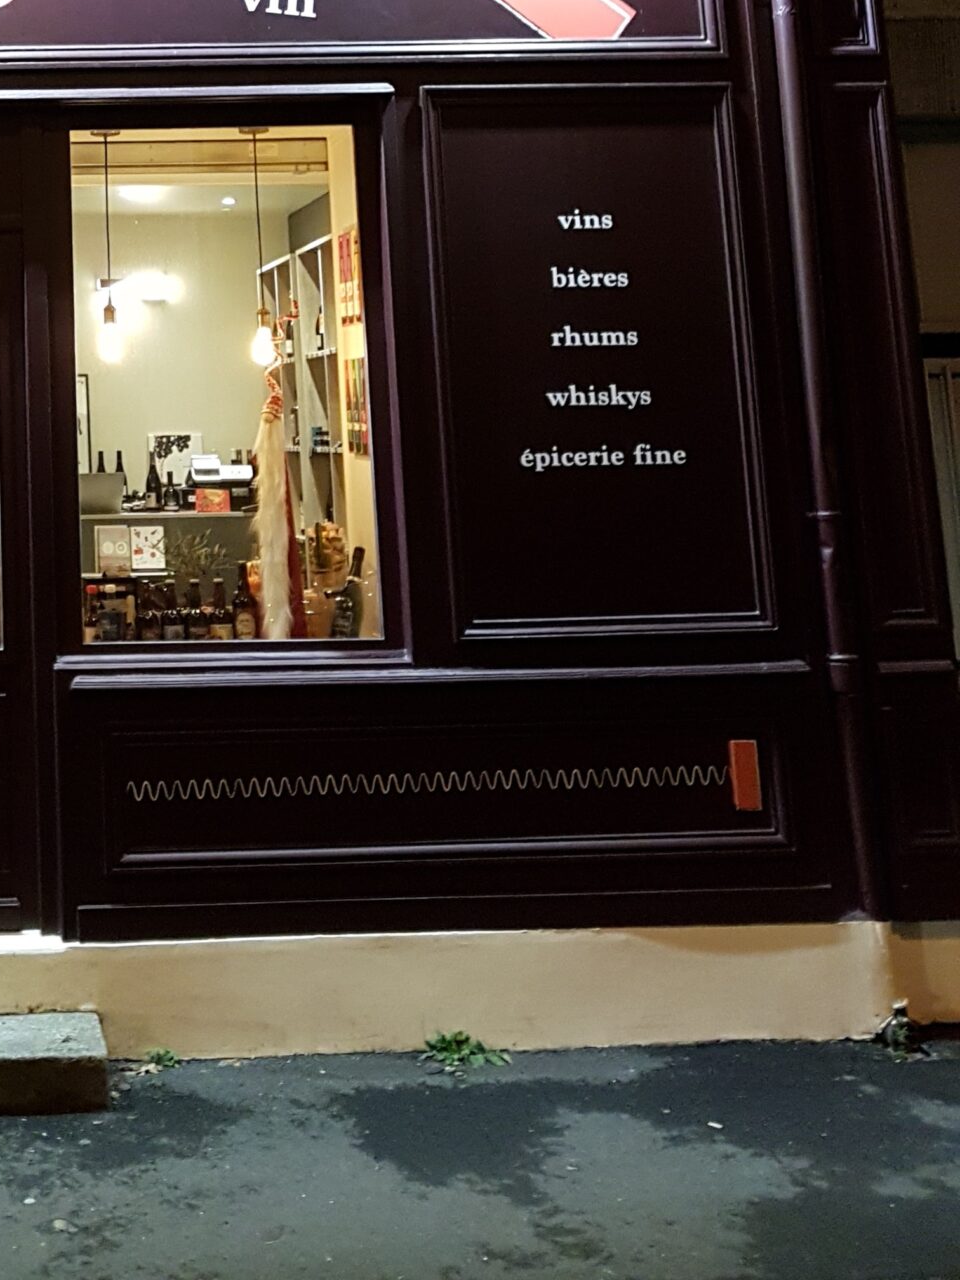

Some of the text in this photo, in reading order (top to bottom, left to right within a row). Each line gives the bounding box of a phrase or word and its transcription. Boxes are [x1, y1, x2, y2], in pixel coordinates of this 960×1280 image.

[557, 209, 613, 230] vins
[550, 267, 629, 288] bières
[550, 325, 638, 347] rhums
[546, 384, 652, 409] whiskys
[520, 443, 687, 471] épicerie fine
